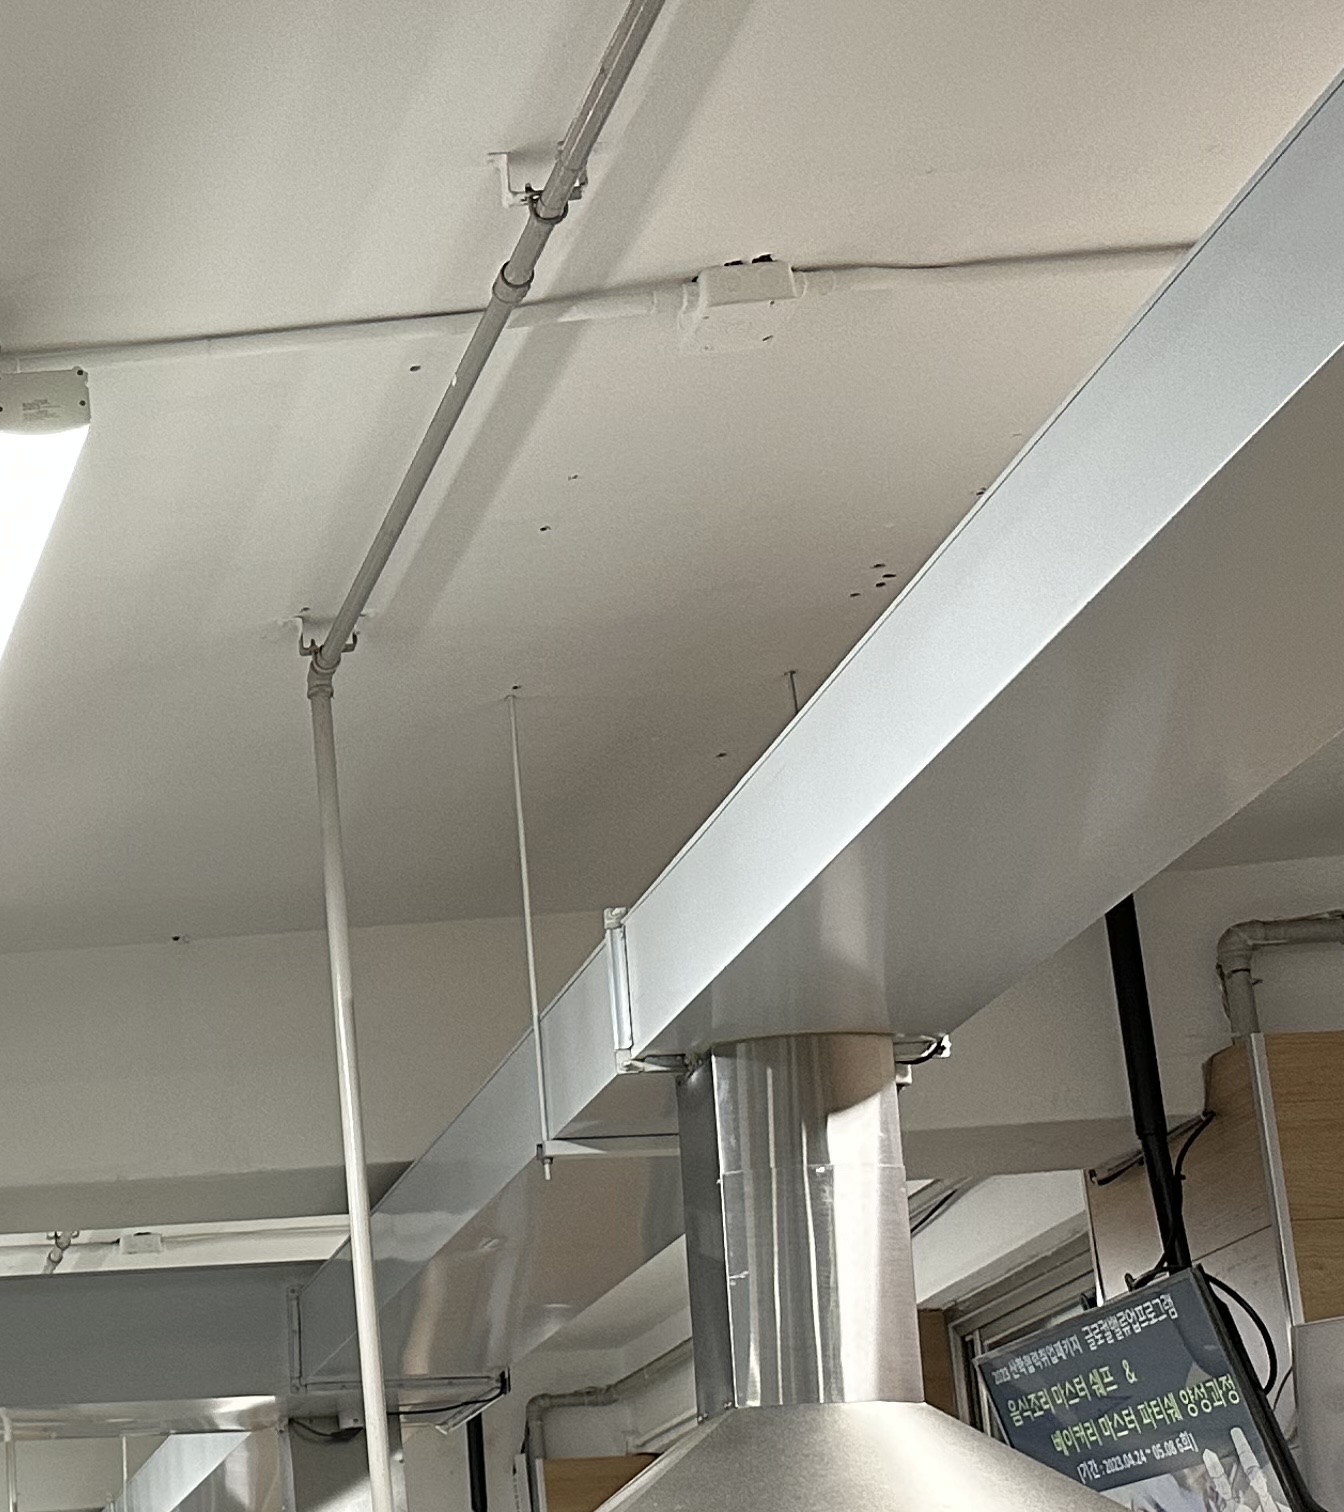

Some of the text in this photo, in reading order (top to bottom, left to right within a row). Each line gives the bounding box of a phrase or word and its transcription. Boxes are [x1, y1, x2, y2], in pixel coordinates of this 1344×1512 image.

[1050, 1374, 1092, 1409] 마스터
[1121, 1359, 1138, 1384] &
[1100, 1406, 1142, 1441] 마스터
[1179, 1373, 1240, 1418] 양성과정
